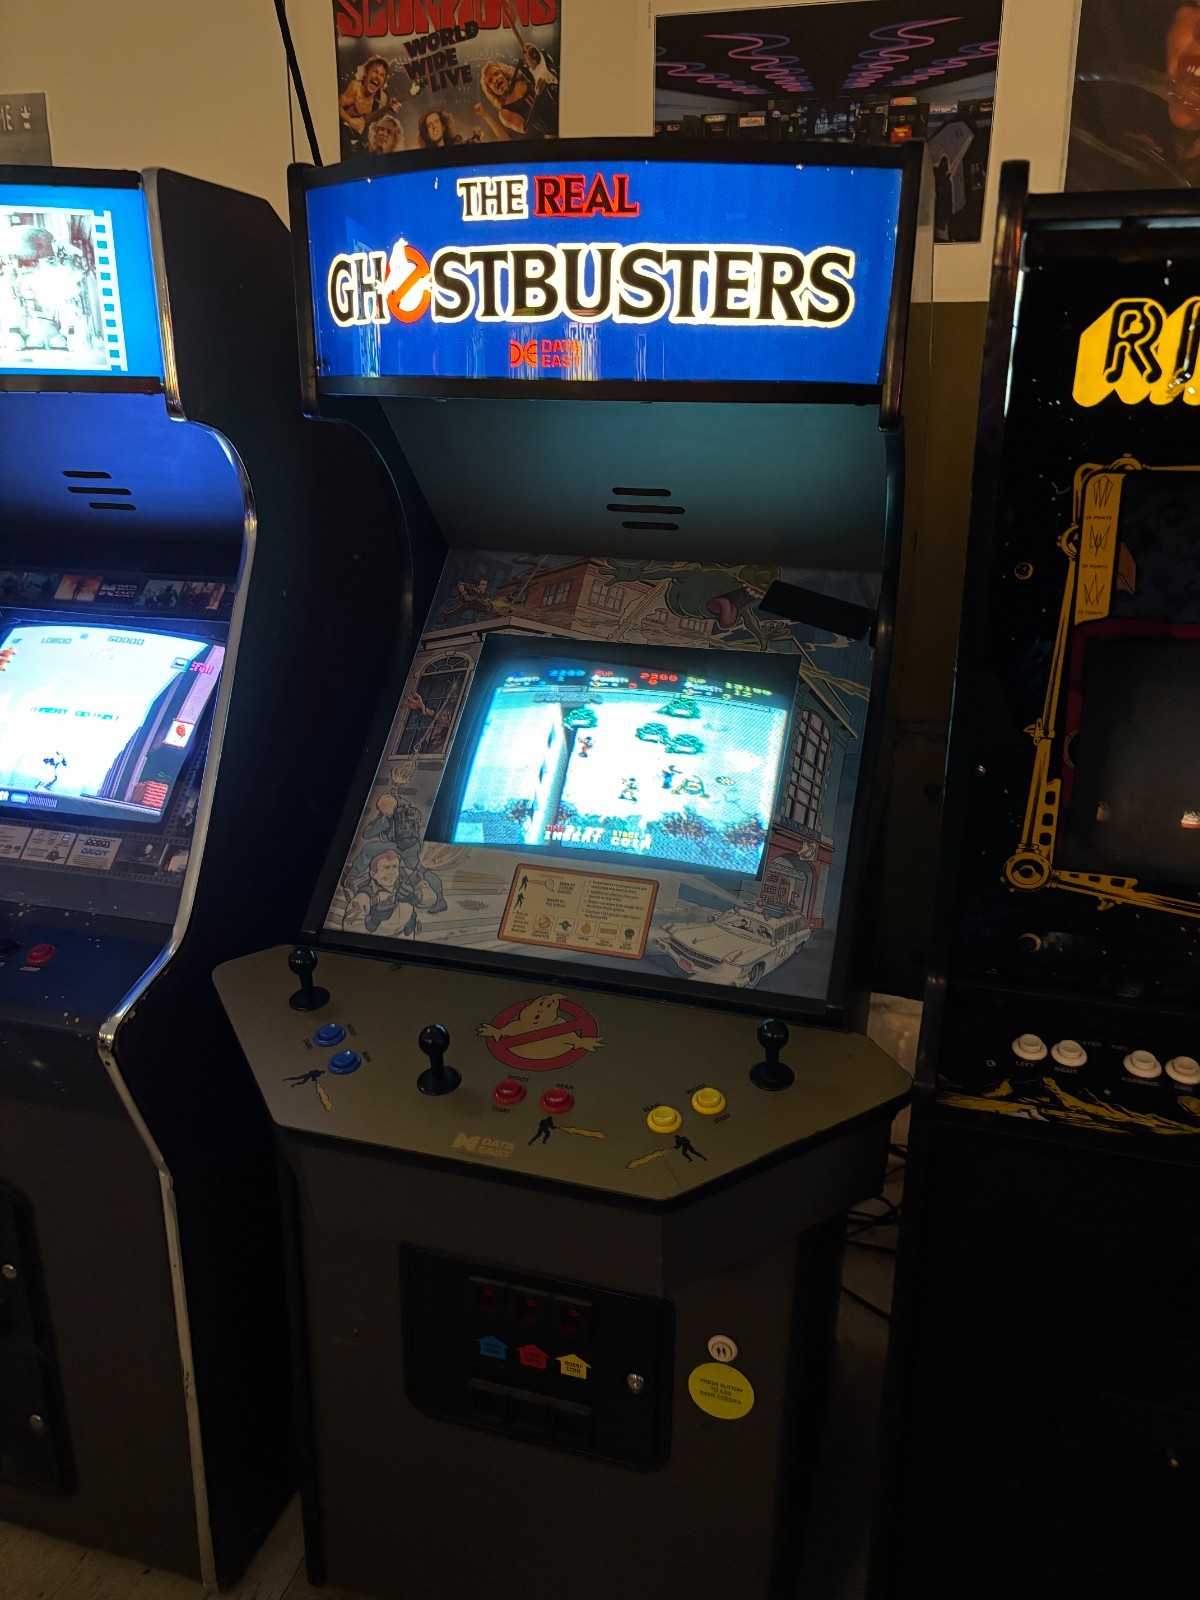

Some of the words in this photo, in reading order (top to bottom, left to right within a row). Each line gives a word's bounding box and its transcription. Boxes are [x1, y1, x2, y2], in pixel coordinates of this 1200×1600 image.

[403, 21, 479, 58] WORLD
[404, 47, 458, 80] WIDE
[427, 64, 473, 93] LIVE
[457, 175, 529, 222] THE
[533, 173, 640, 218] REAL
[541, 339, 582, 353] DATA
[541, 354, 582, 368] EAST
[477, 1145, 512, 1158] EAST
[481, 1137, 515, 1152] DATA
